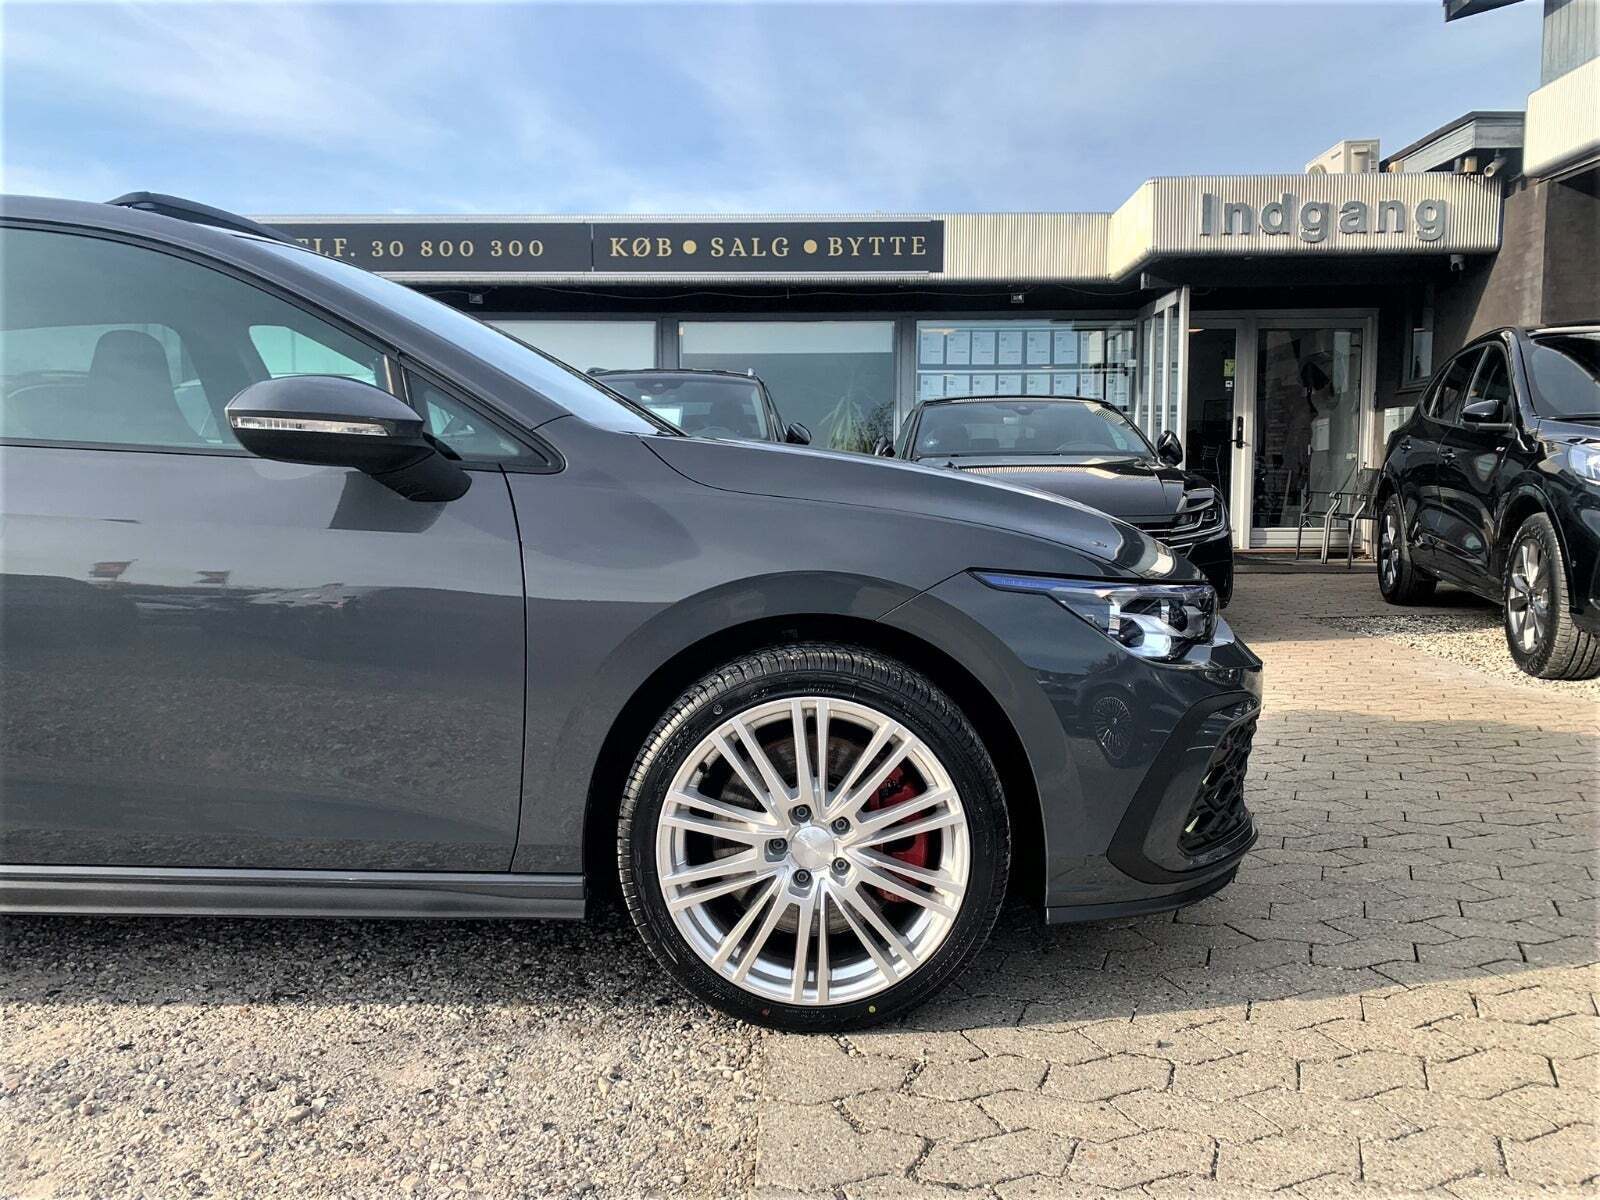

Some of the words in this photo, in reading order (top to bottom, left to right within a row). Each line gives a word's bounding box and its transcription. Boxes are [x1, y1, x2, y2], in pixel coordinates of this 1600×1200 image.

[1200, 192, 1447, 243] Indgang
[371, 240, 404, 257] 30
[420, 240, 474, 257] 800
[490, 240, 544, 257] 300
[609, 236, 673, 258] KØB
[710, 236, 790, 257] SALG
[827, 235, 927, 256] BYTTE
